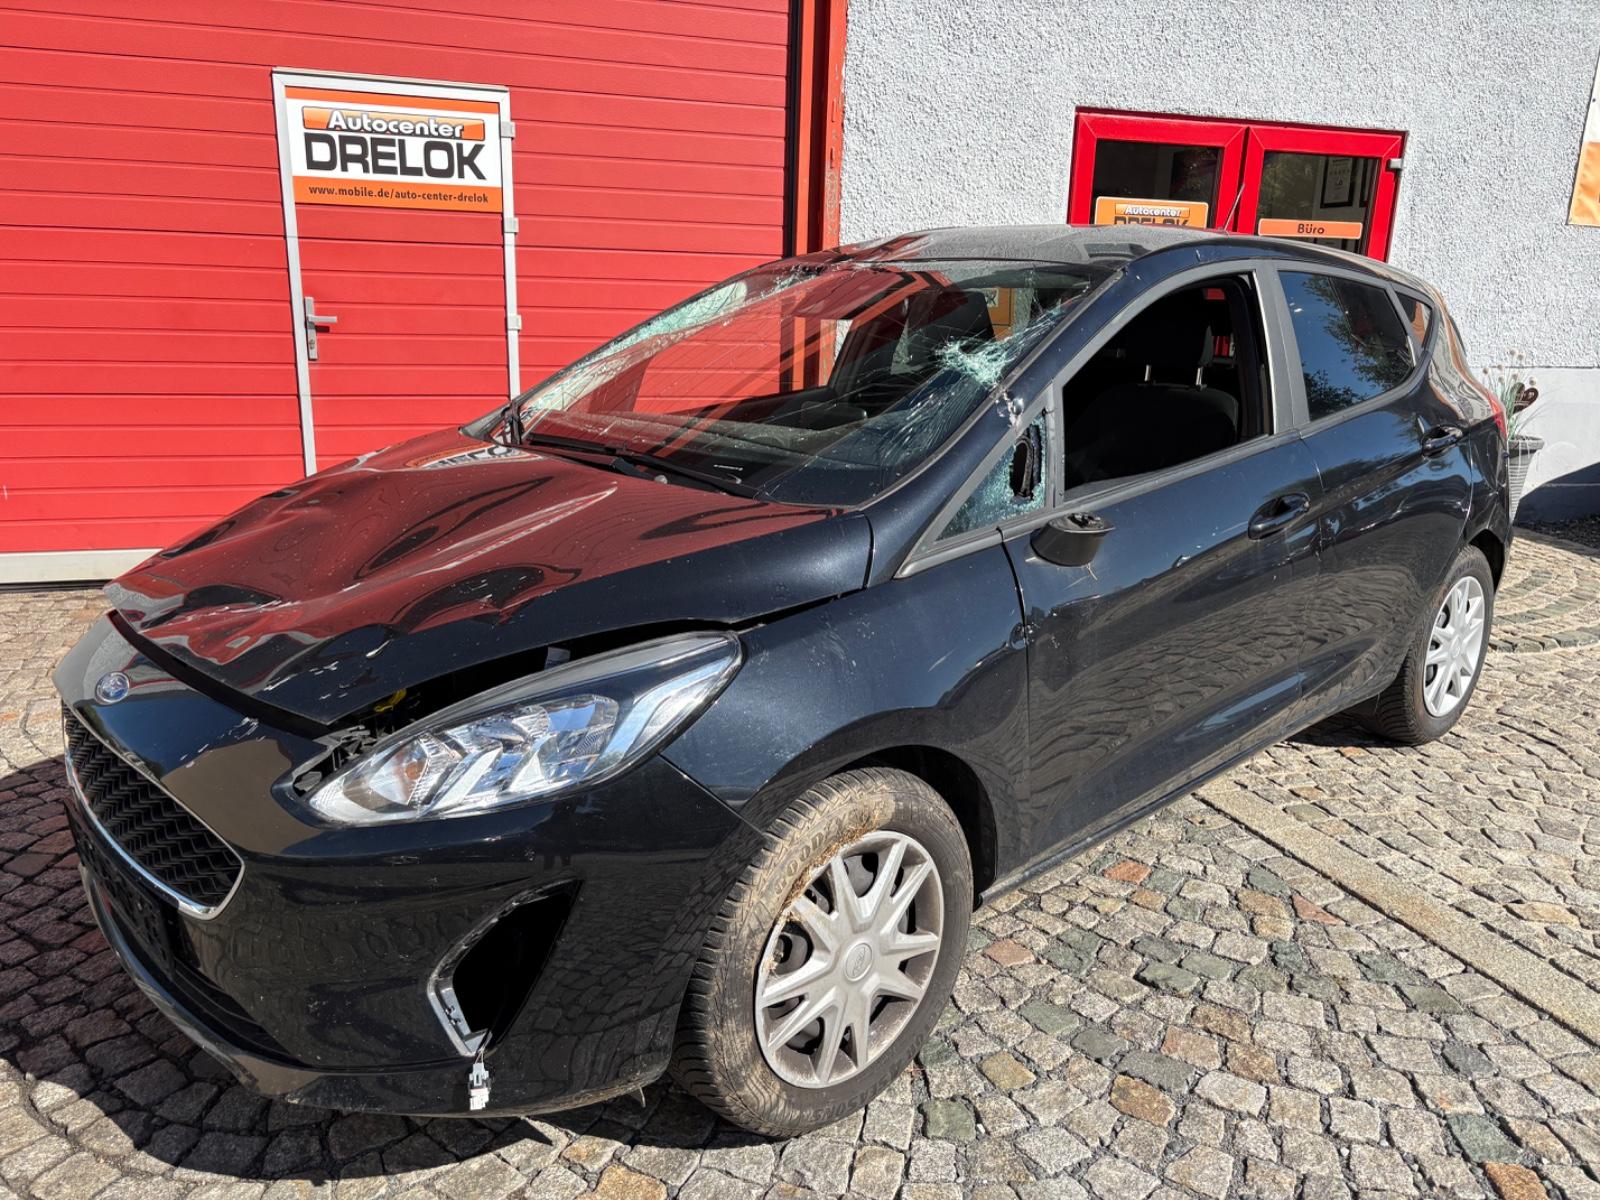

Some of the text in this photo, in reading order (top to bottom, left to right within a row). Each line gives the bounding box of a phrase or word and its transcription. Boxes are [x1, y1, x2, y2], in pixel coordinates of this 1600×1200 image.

[328, 110, 465, 138] Autocenter
[304, 132, 486, 180] DRELOK
[308, 185, 489, 203] www.mobile.de/auto-center-drelok
[1125, 205, 1181, 217] Autocenter
[1297, 223, 1325, 234] Büro
